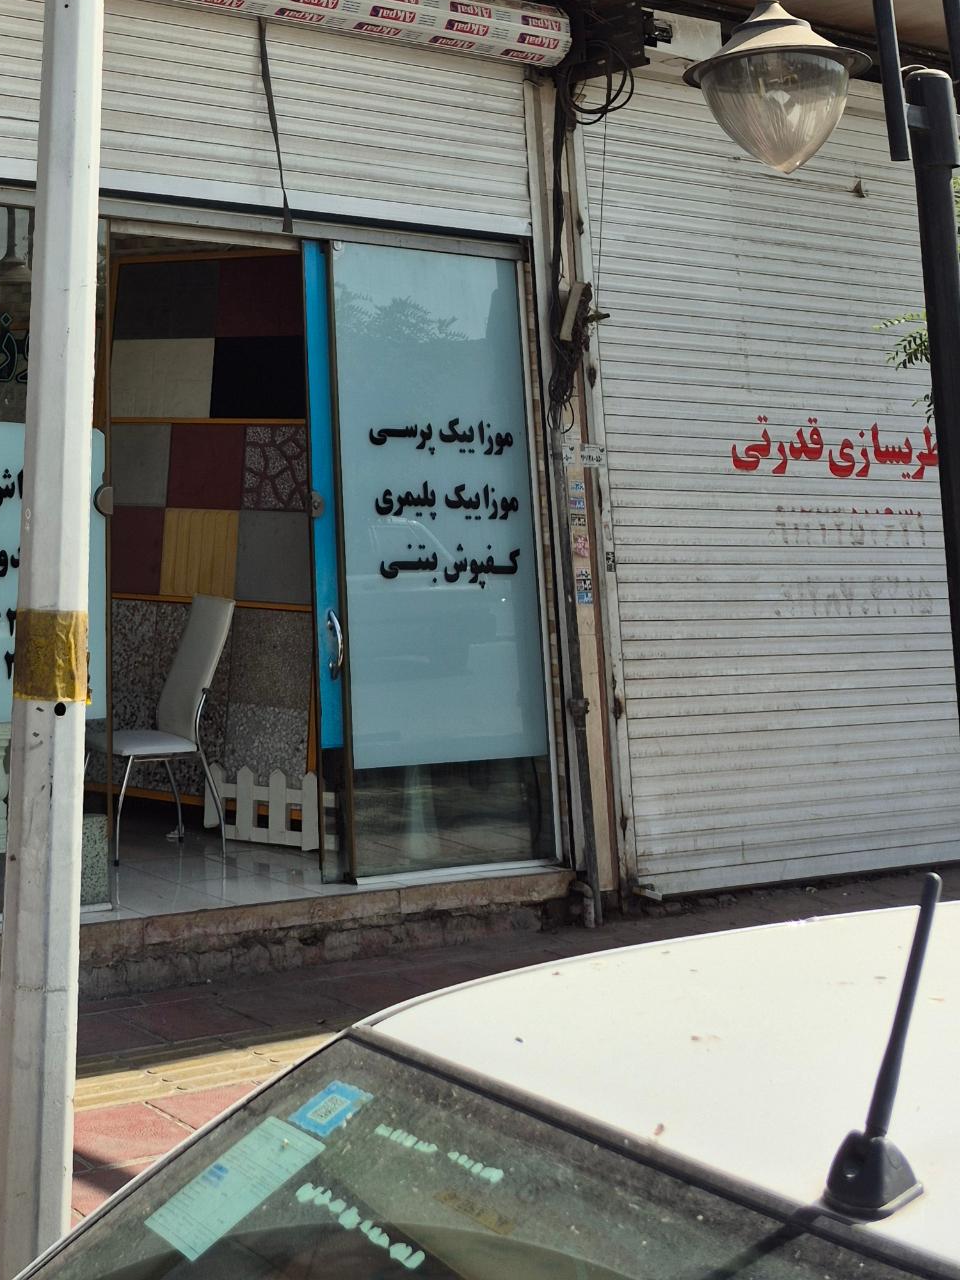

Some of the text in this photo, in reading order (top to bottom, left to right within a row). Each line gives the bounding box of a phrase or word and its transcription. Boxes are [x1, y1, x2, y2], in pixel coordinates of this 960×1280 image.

[284, 8, 326, 23] Akpal
[378, 6, 417, 24] Akpal
[457, 3, 493, 19] Akpal
[363, 22, 403, 37] Akpal
[452, 20, 490, 37] Akpal
[528, 17, 562, 32] Akpal
[438, 36, 477, 50] Akpal
[525, 33, 561, 50] Akpal
[510, 49, 546, 62] Akpal
[368, 417, 514, 455] موزاییک پرسی
[731, 415, 939, 480] طریسازی قدرتی
[375, 480, 520, 520] موزاییک پلیمری
[379, 543, 521, 589] کفپوش بتنی
